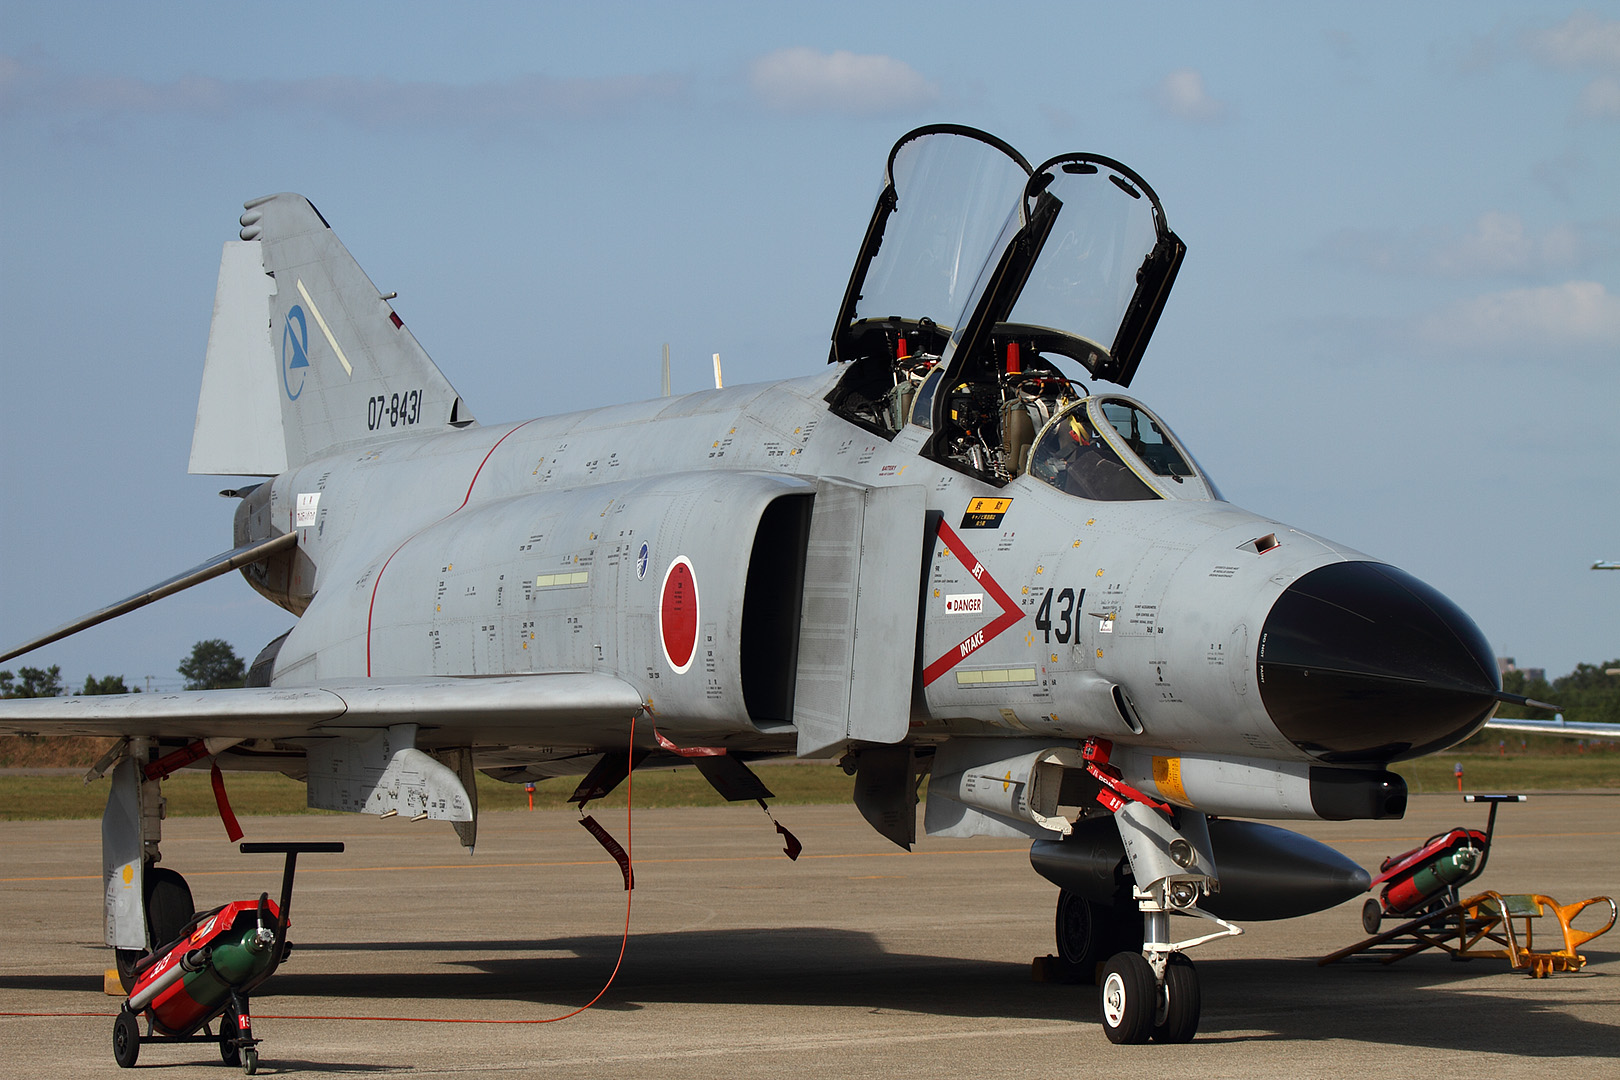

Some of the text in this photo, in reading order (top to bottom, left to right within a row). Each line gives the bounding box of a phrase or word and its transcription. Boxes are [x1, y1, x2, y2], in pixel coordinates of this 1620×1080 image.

[368, 389, 422, 430] 07-8431
[971, 561, 985, 580] JET
[953, 599, 982, 612] DANGER
[1035, 588, 1086, 644] 431
[960, 630, 985, 657] INTAKE
[1262, 633, 1268, 643] DO
